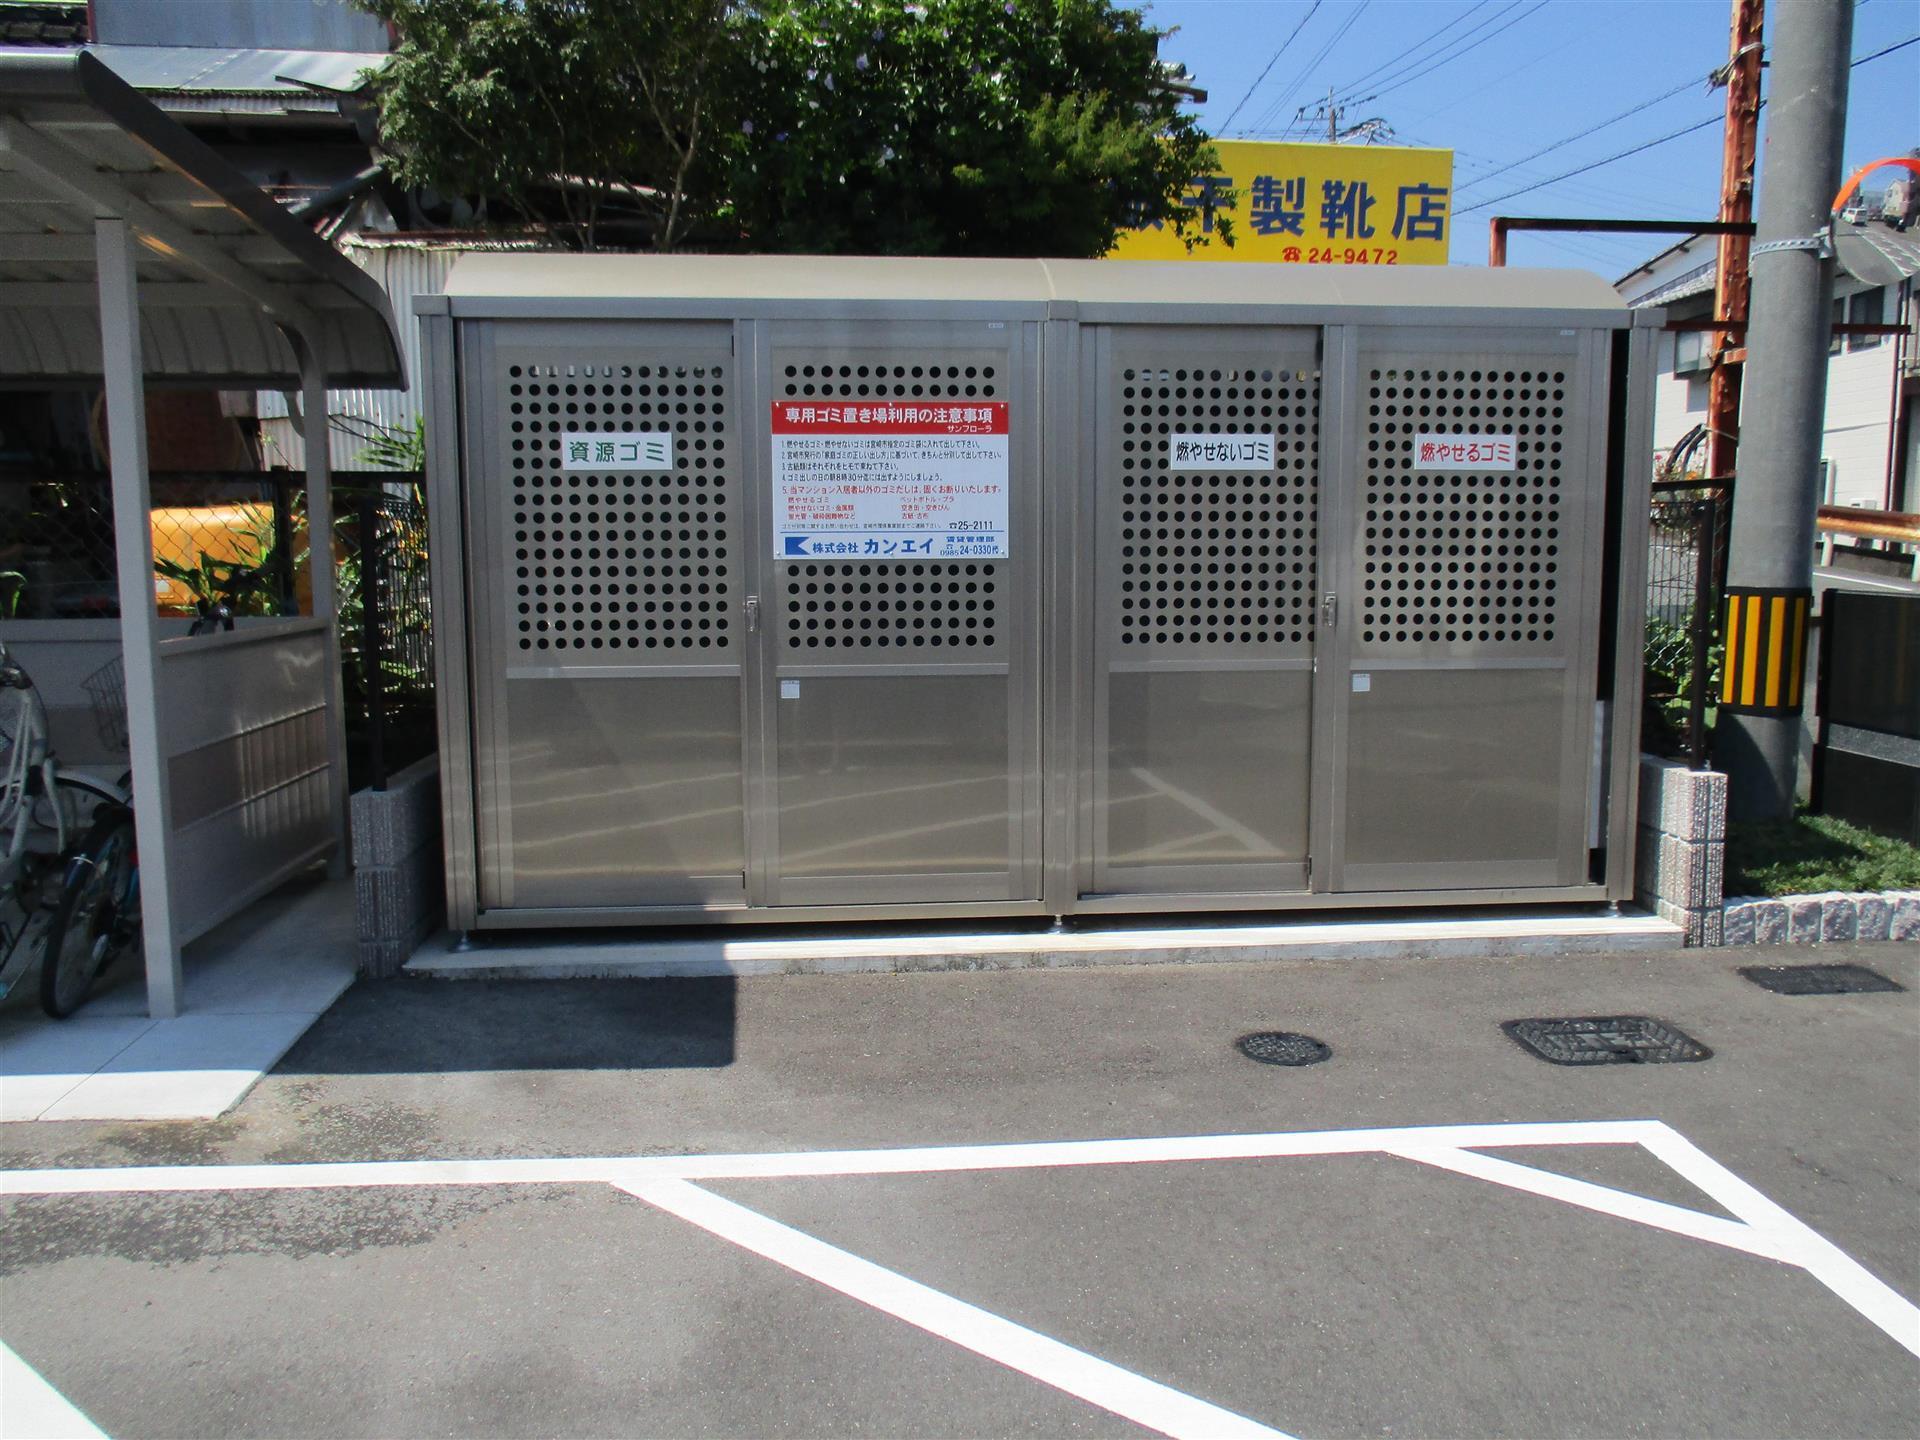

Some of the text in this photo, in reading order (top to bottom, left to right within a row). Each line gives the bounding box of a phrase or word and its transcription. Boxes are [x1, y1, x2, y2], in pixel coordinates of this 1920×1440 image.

[1114, 174, 1449, 242] 干製靴店
[1308, 247, 1398, 266] 24-9472
[785, 406, 994, 424] 専用ゴミ置き場利用の注意事項
[946, 424, 993, 433] サンフローラ
[569, 440, 665, 463] 資源ゴミ
[1176, 440, 1270, 462] 燃やせないゴミ
[1420, 440, 1512, 463] 燃やせるゴミ
[958, 520, 994, 530] 25-2111
[812, 537, 935, 555] 株式会社 カンエイ
